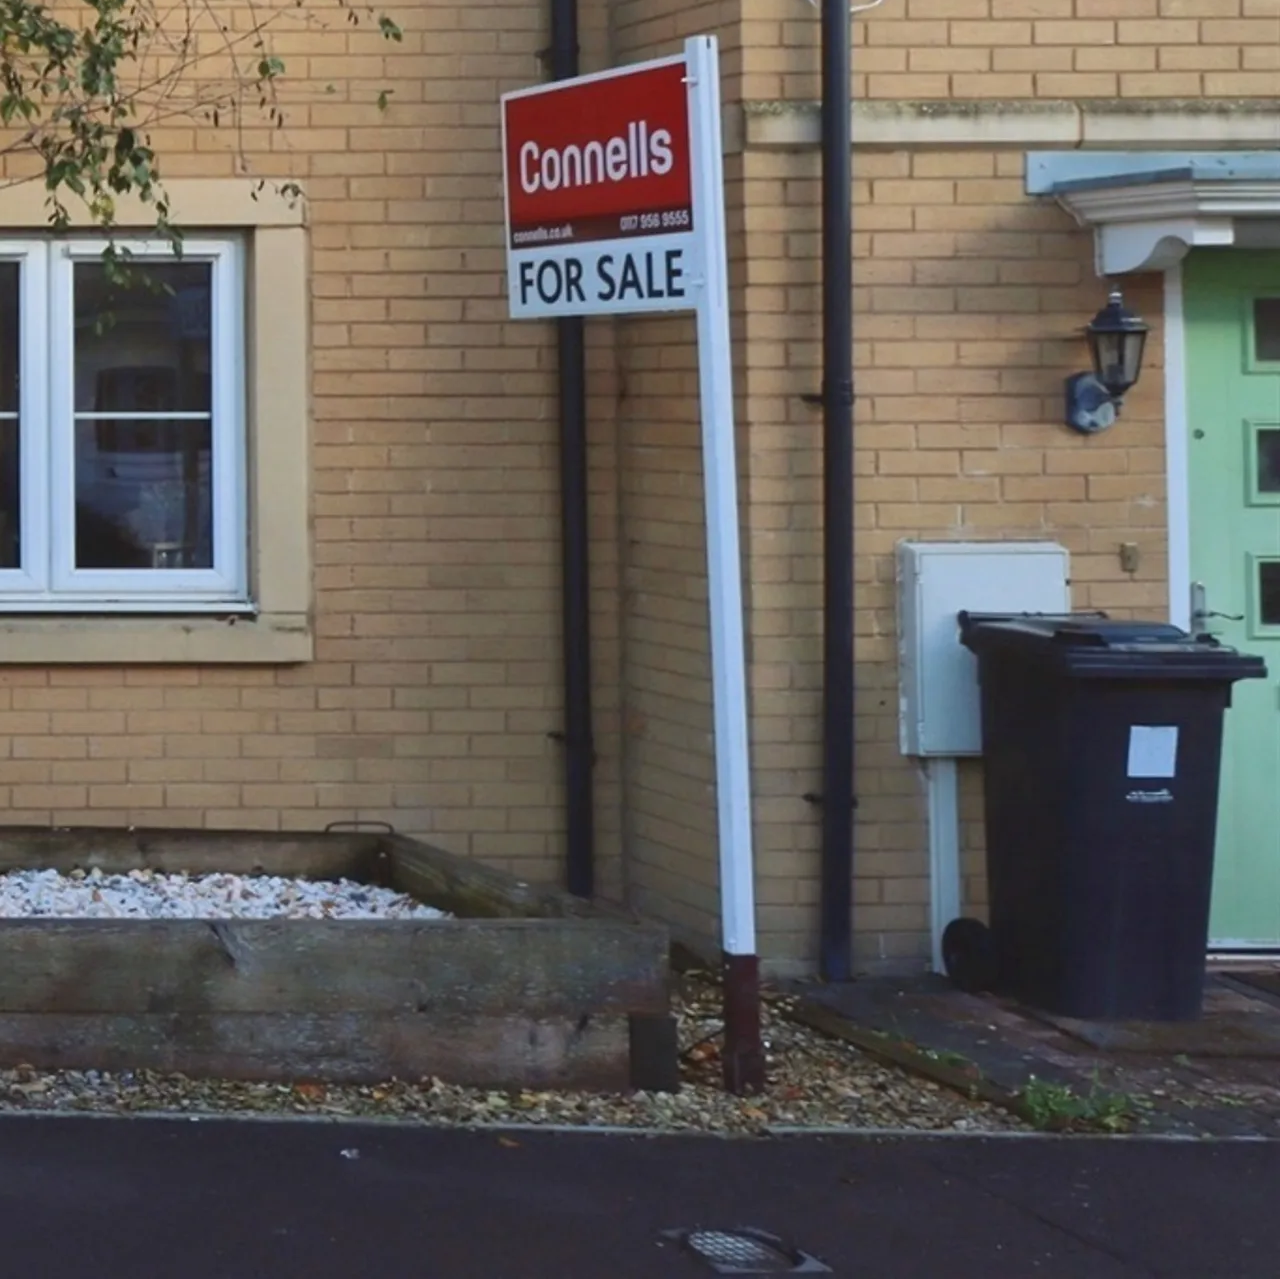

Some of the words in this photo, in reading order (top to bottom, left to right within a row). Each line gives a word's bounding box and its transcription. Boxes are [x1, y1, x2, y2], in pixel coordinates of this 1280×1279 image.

[519, 120, 674, 194] Connells
[519, 257, 586, 306] FOR
[596, 249, 686, 302] SALE
